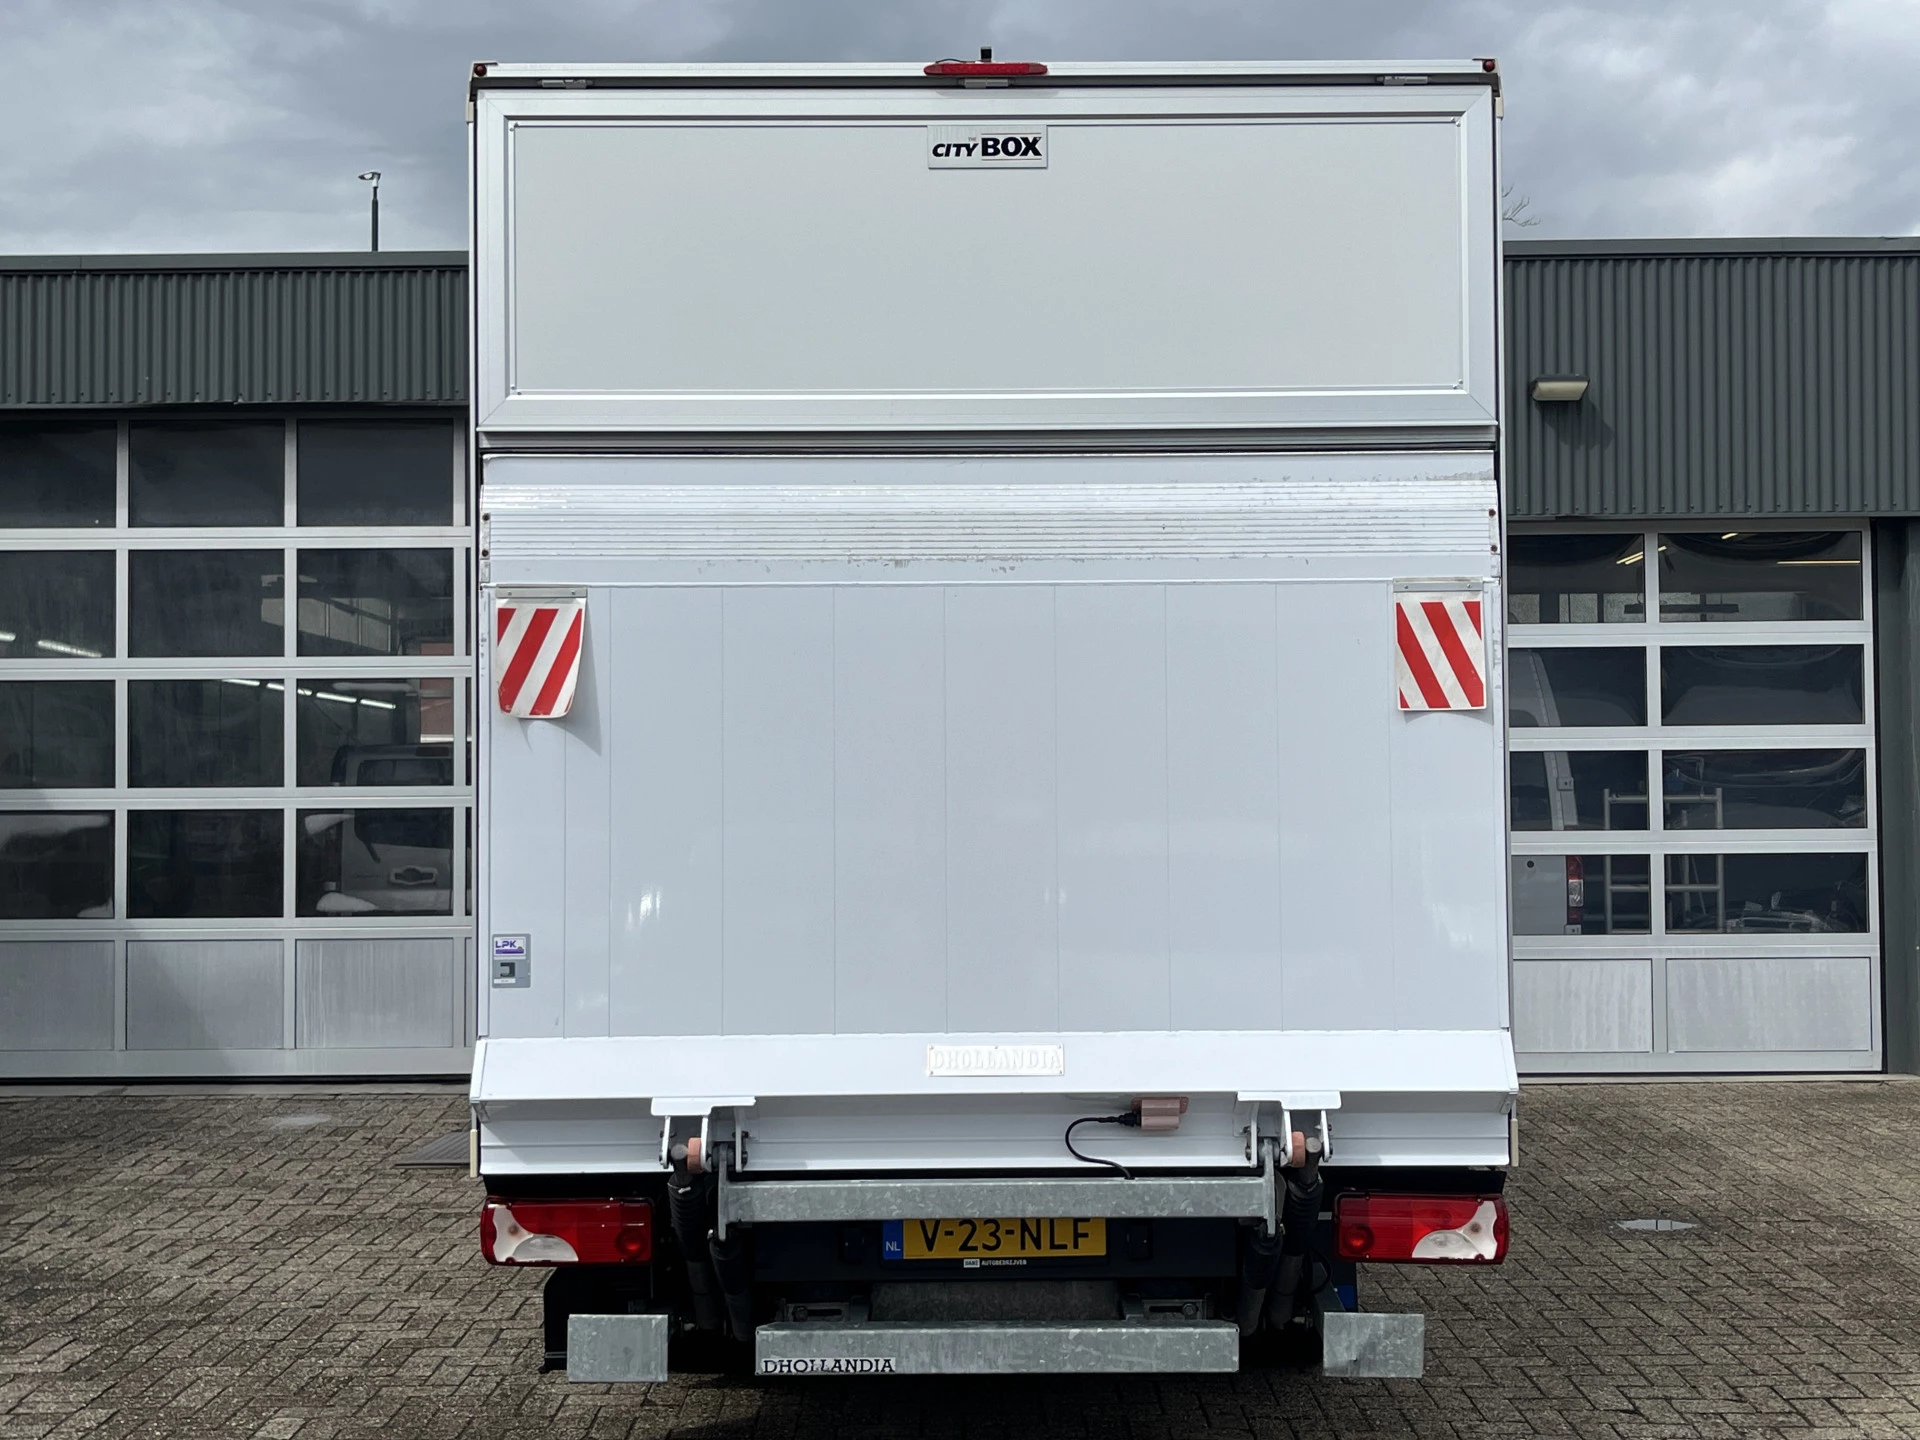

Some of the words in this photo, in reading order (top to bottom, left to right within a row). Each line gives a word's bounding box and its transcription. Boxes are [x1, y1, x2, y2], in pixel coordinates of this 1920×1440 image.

[932, 143, 979, 157] CITY
[981, 136, 1042, 157] BOX
[495, 940, 517, 948] LPK
[933, 1049, 1062, 1070] DHOLLANDIA
[919, 1218, 1091, 1252] V-23-NLF
[885, 1241, 901, 1252] NL
[763, 1359, 895, 1374] DHOLLANDIA
